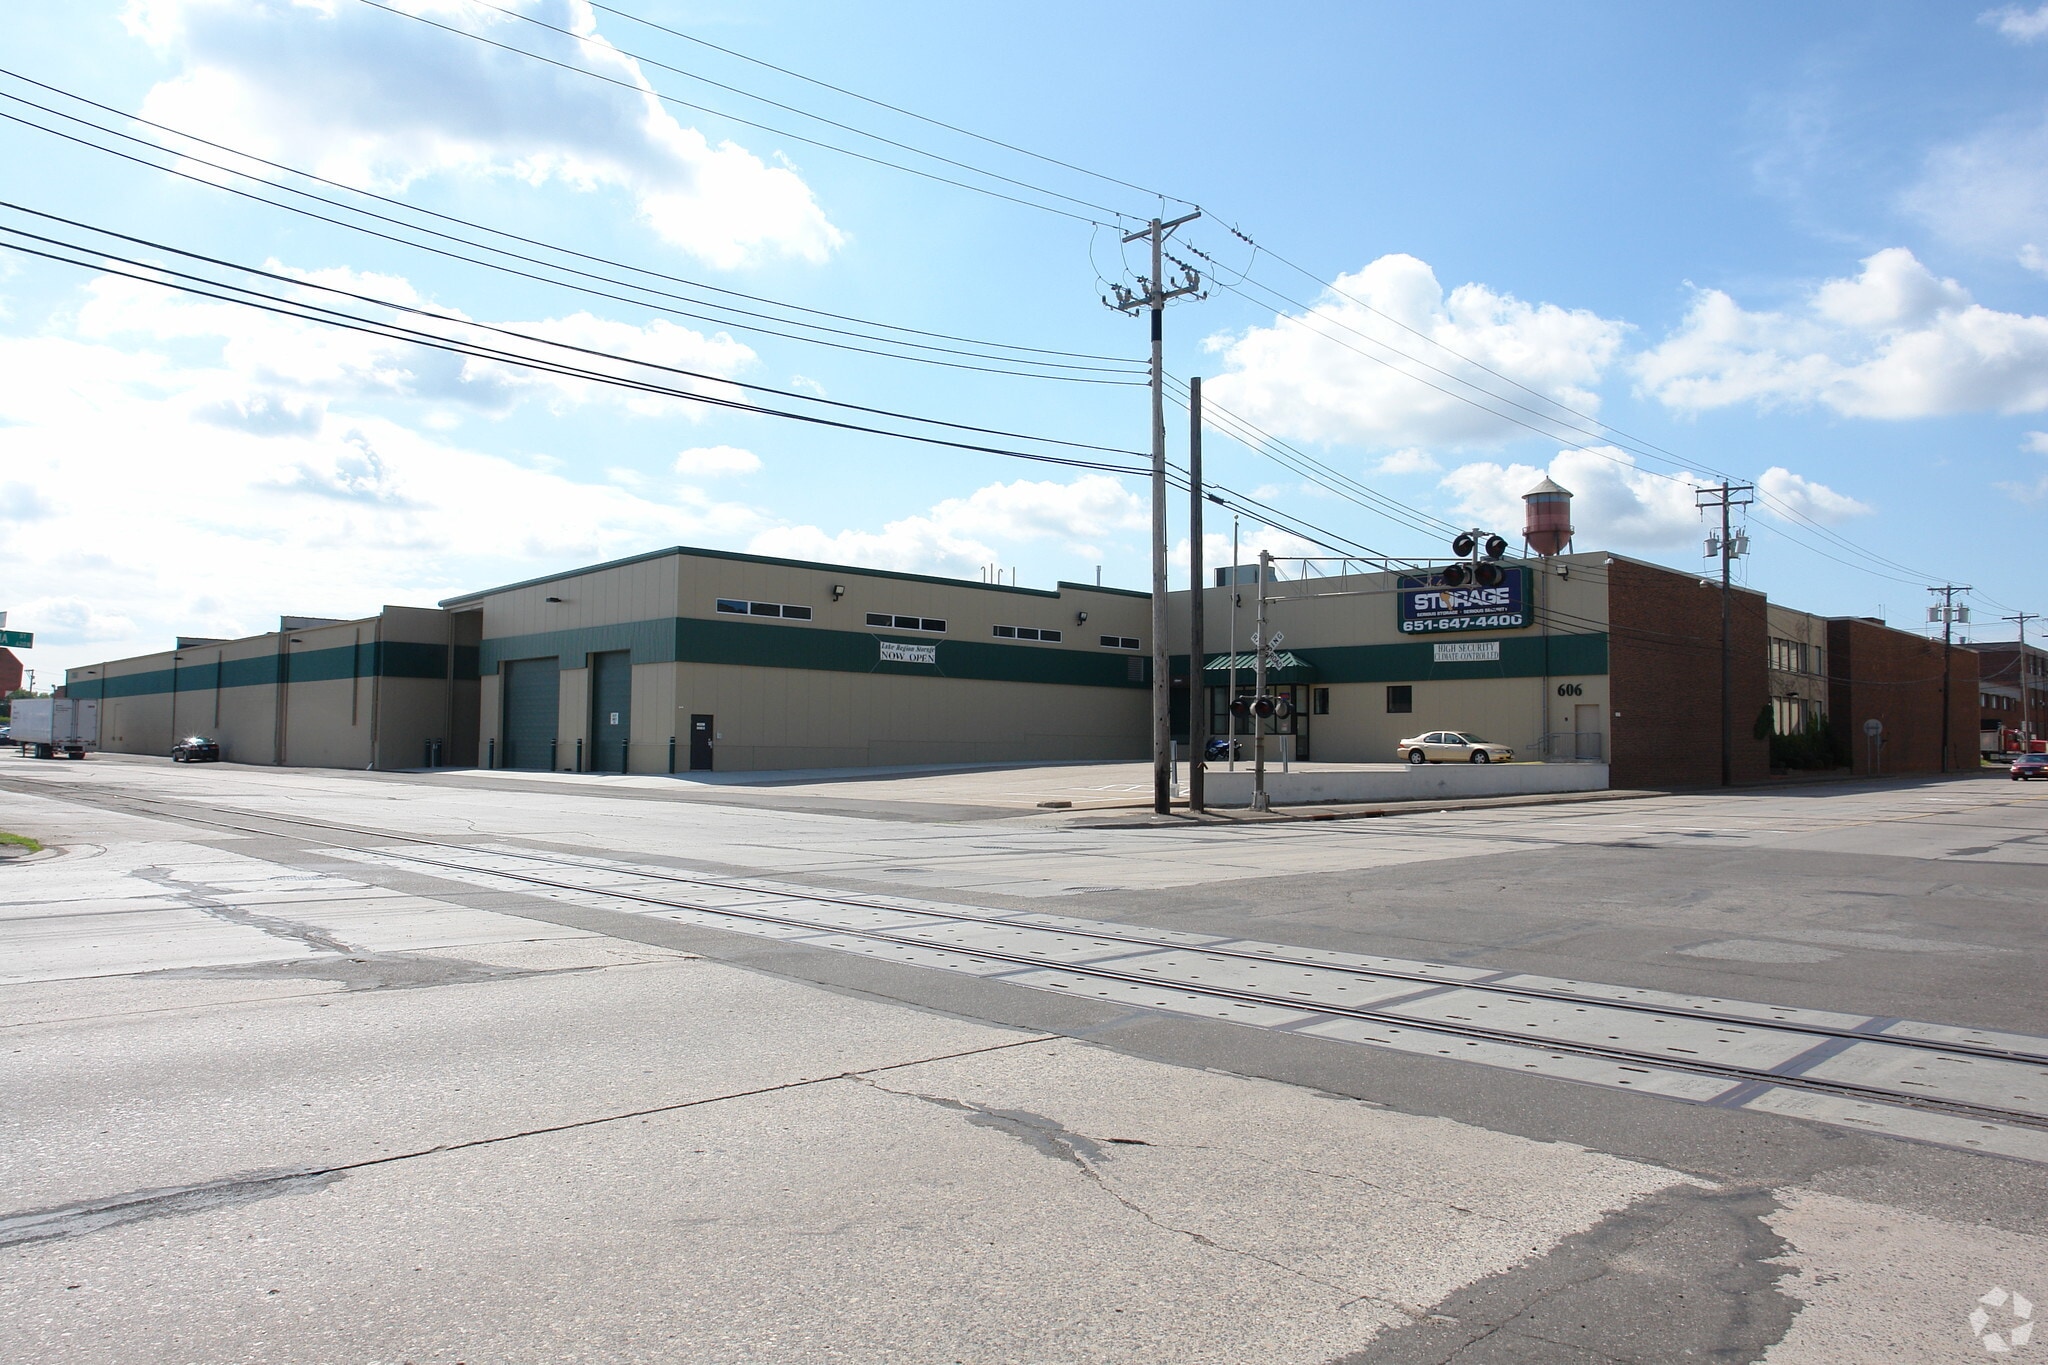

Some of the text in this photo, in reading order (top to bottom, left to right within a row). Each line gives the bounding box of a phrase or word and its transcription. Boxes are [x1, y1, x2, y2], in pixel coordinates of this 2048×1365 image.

[1414, 587, 1510, 610] STORAGE
[1403, 614, 1522, 631] 651-647-4400
[881, 642, 895, 650] Lake
[896, 644, 915, 652] Region
[1438, 642, 1495, 653] HIGH SECURITY
[881, 651, 936, 662] NOW OPEN
[1434, 651, 1499, 661] CLIMATE CONTROLLED
[1557, 683, 1583, 697] 606
